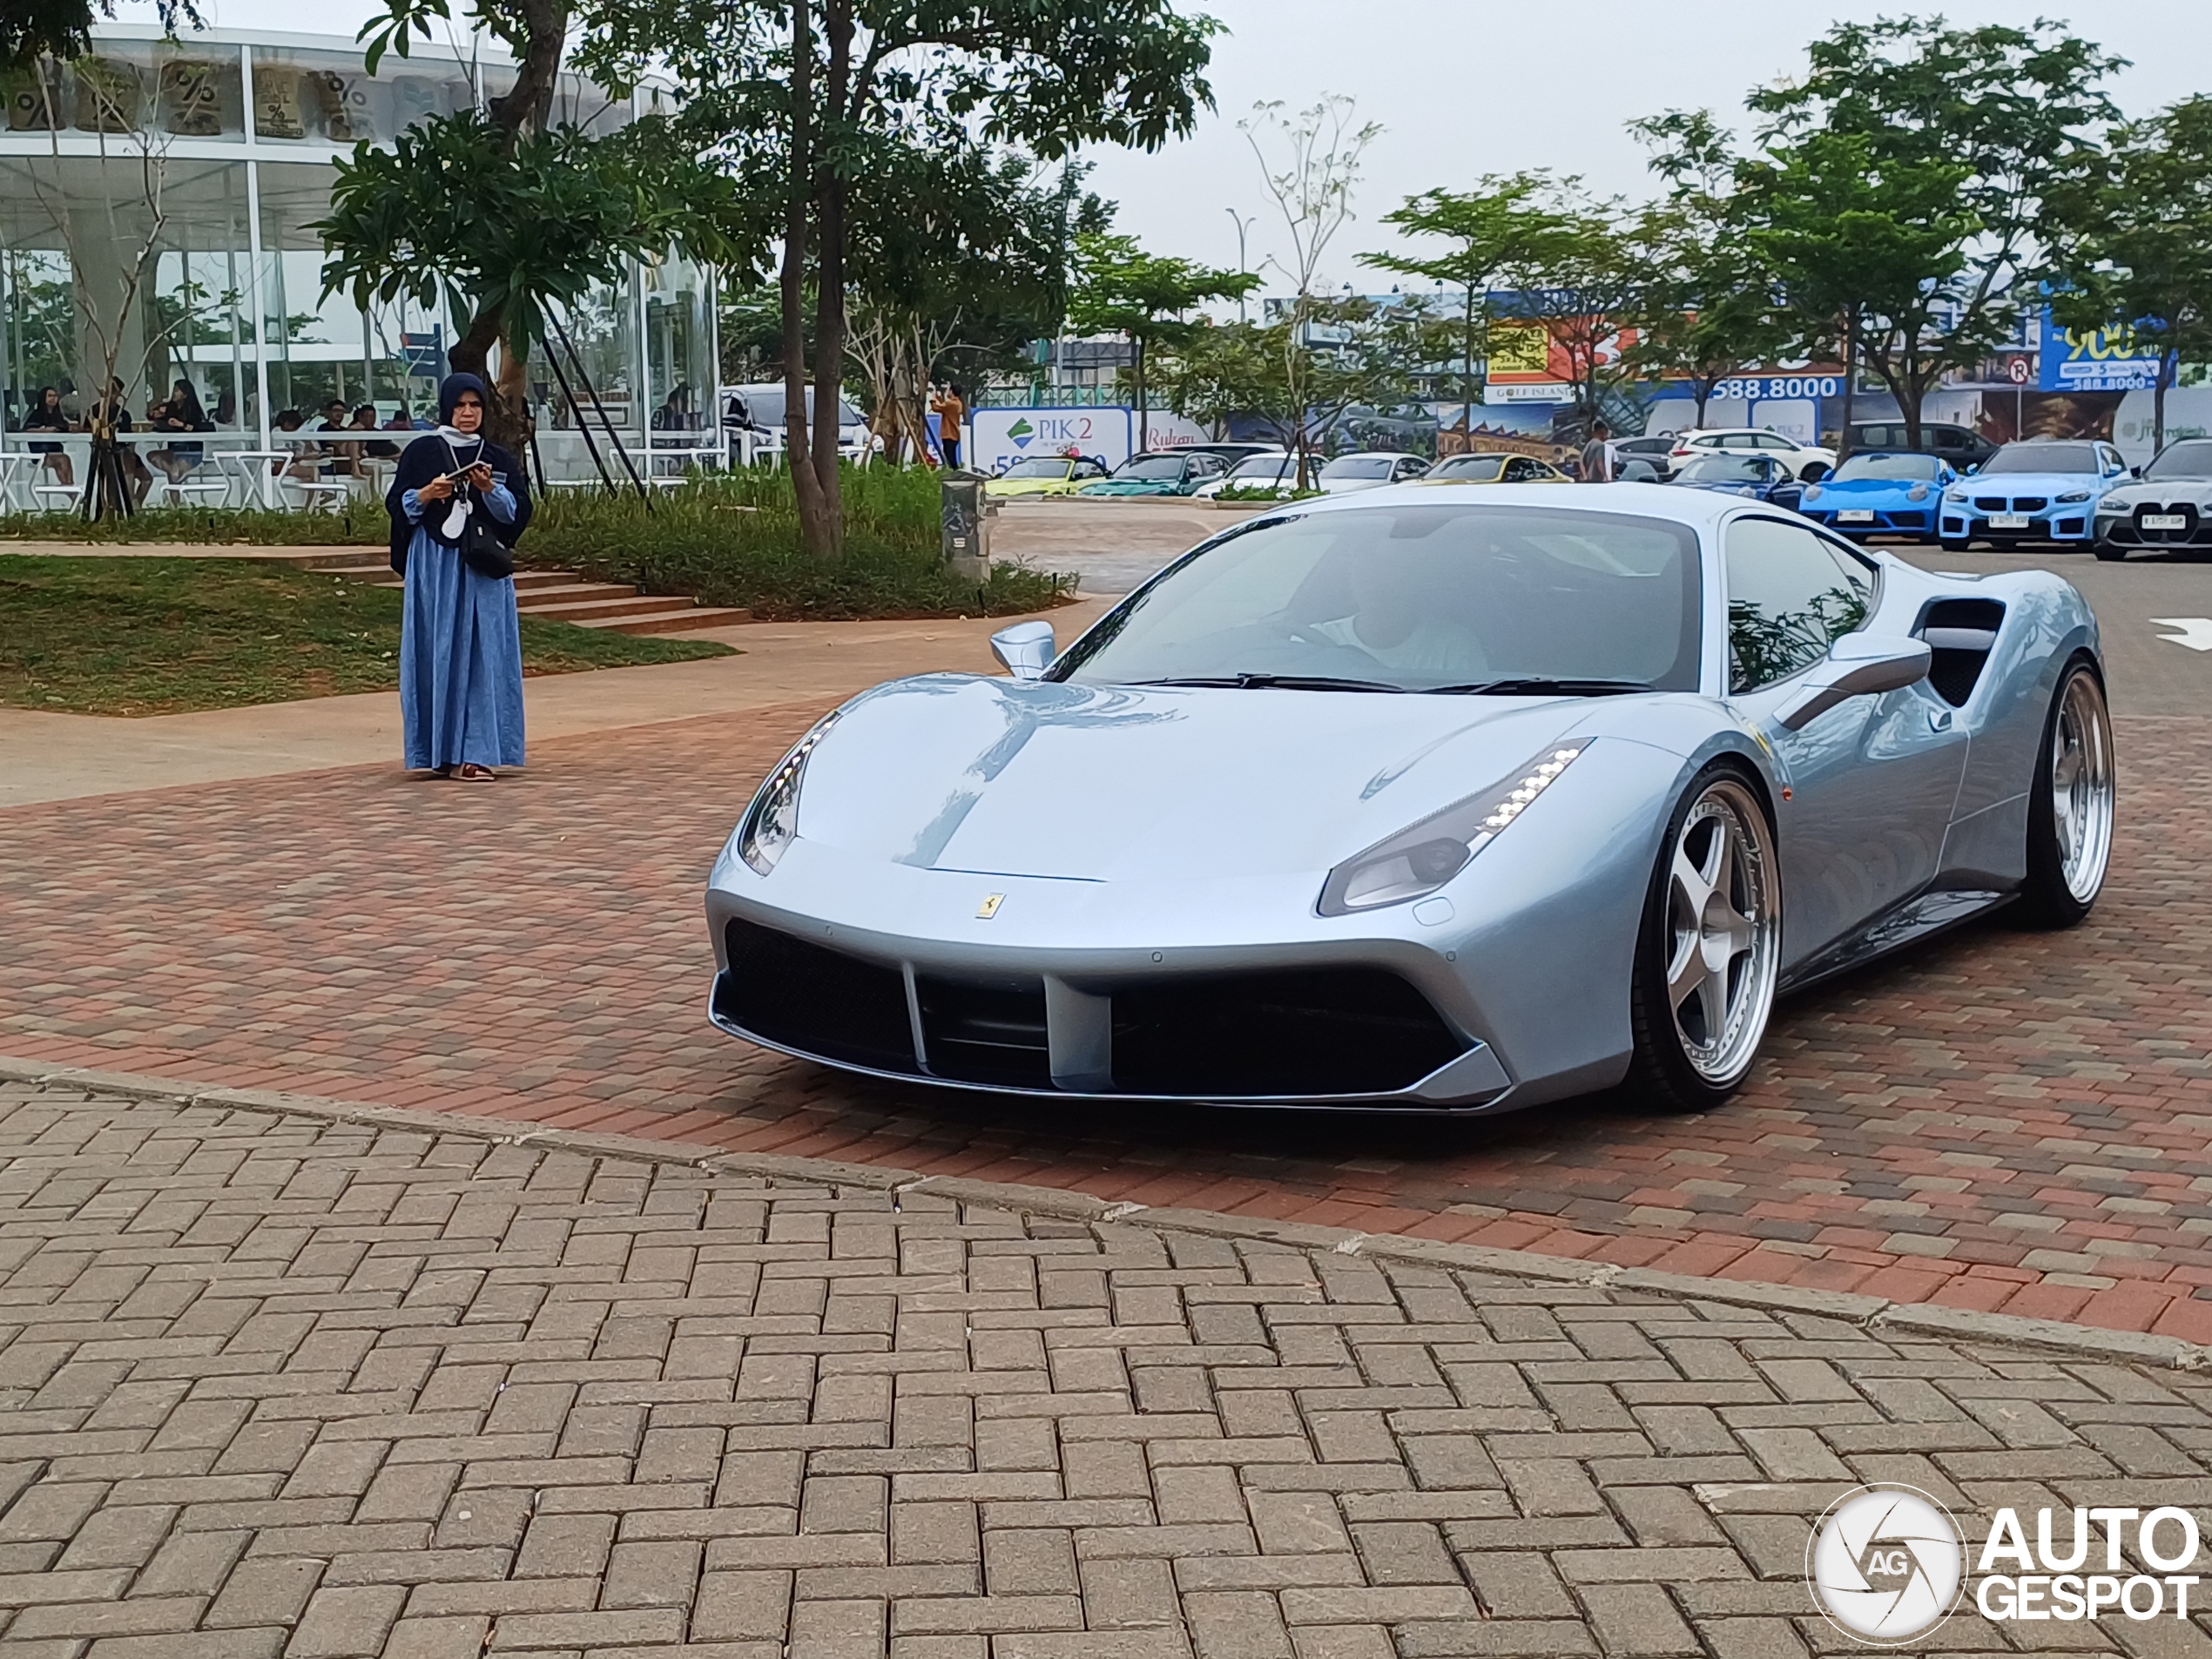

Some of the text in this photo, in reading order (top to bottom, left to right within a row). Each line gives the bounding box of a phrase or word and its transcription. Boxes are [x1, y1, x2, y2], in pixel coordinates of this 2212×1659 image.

[1713, 377, 1836, 400] 588.8000
[1039, 417, 1093, 439] PIK 2
